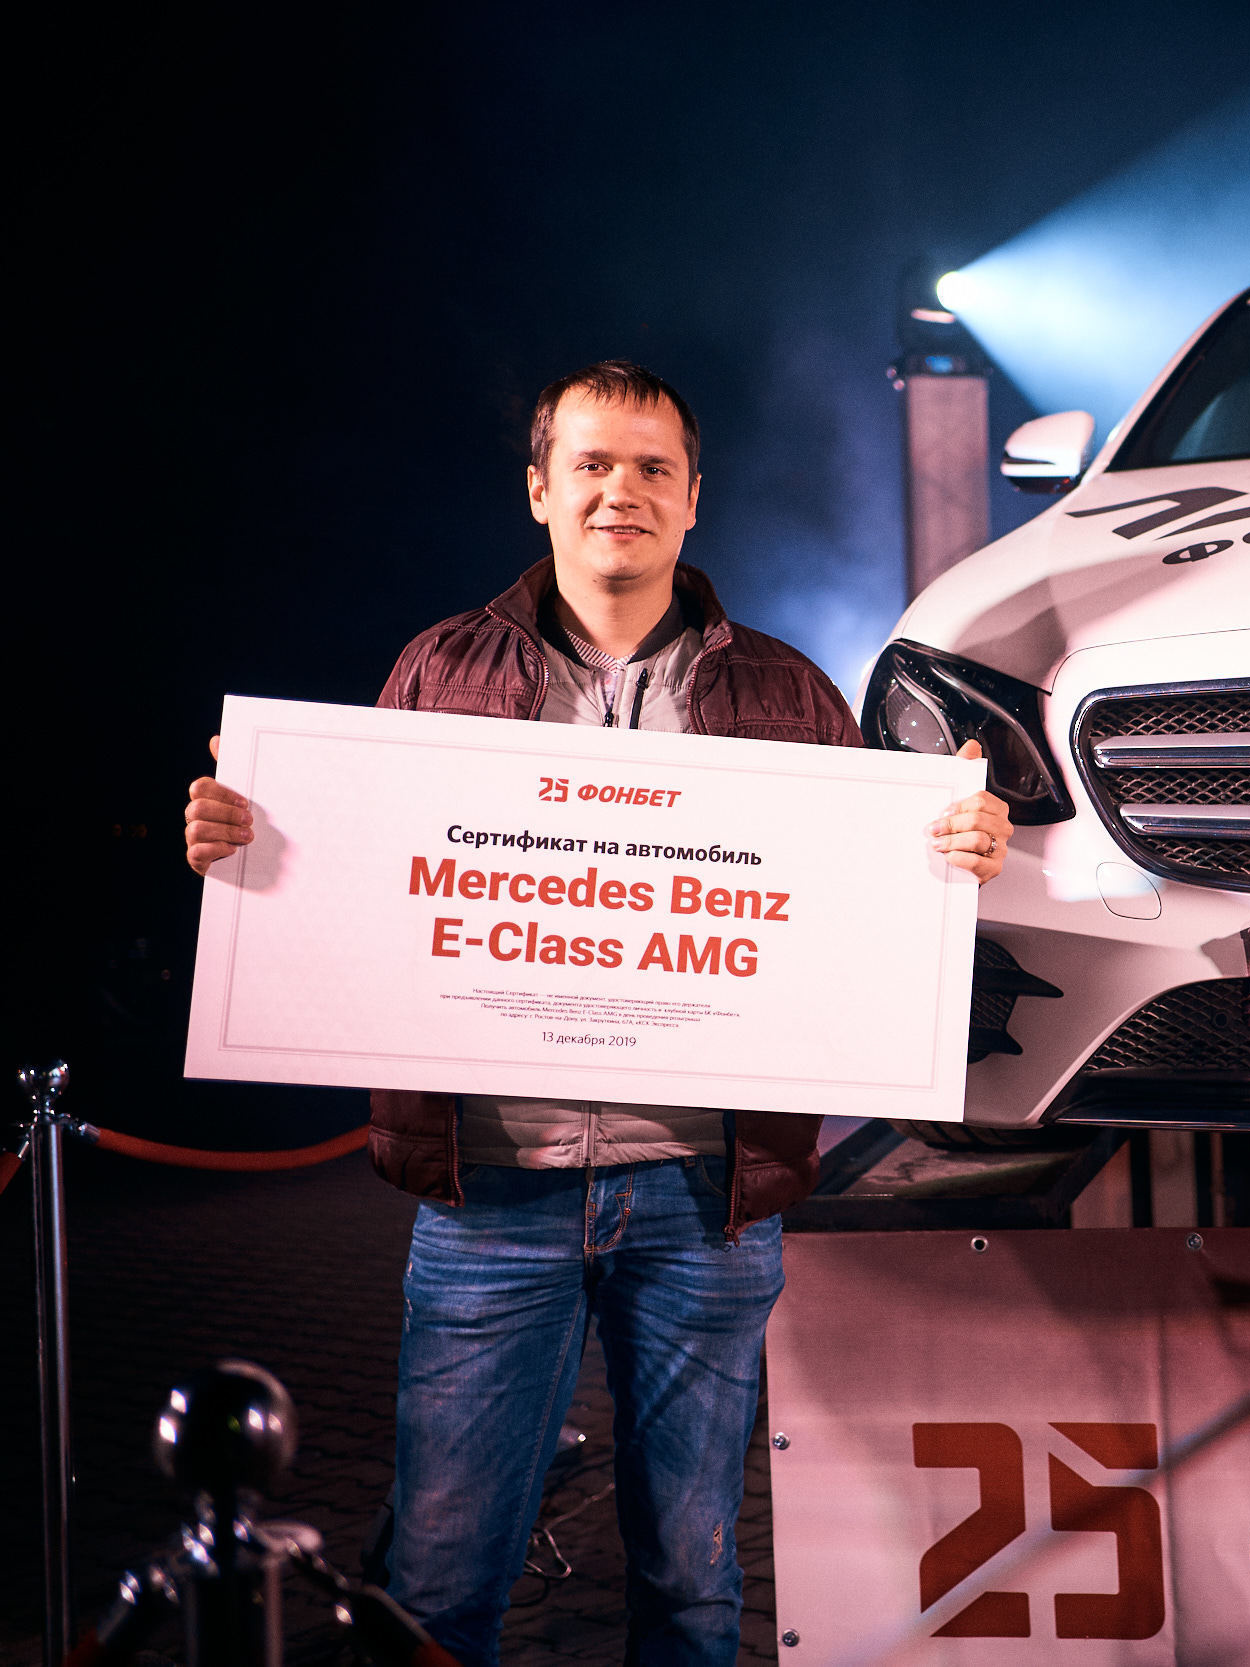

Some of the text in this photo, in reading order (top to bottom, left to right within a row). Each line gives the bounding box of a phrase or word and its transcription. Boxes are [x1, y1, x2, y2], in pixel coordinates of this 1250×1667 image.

[577, 783, 682, 808] ФОНБЕТ
[446, 824, 763, 866] Сертификат на автомобиль
[408, 855, 791, 922] Mercedes Benz
[431, 917, 759, 978] E-Class AMG
[541, 1031, 637, 1047] 13 декабря 2019
